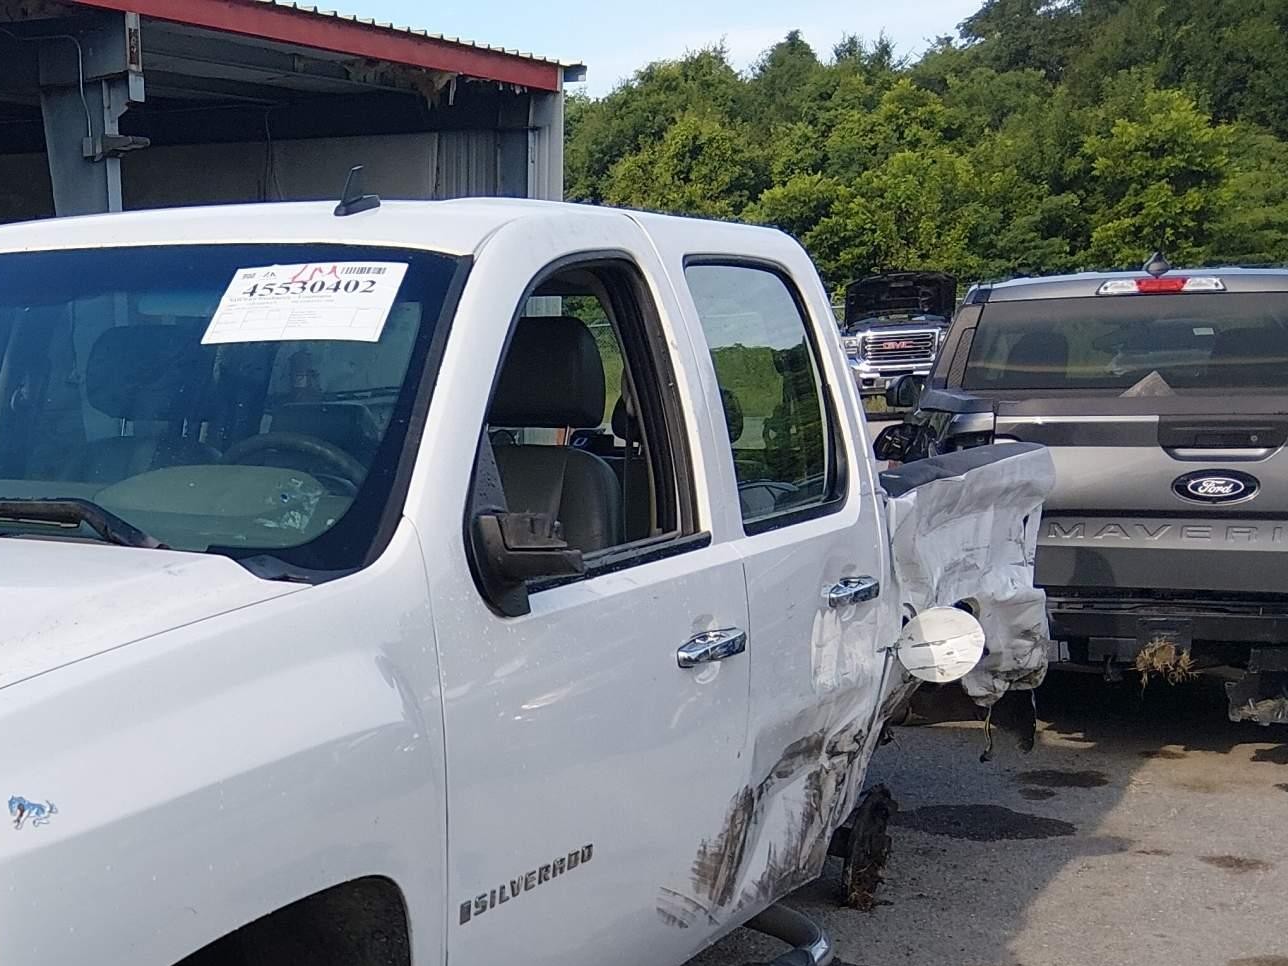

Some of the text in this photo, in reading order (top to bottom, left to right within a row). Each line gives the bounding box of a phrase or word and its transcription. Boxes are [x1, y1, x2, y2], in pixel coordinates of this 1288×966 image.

[242, 279, 376, 297] 45530402
[882, 341, 914, 350] GMC
[1197, 479, 1233, 496] Ford
[473, 843, 594, 917] SILVERADO
